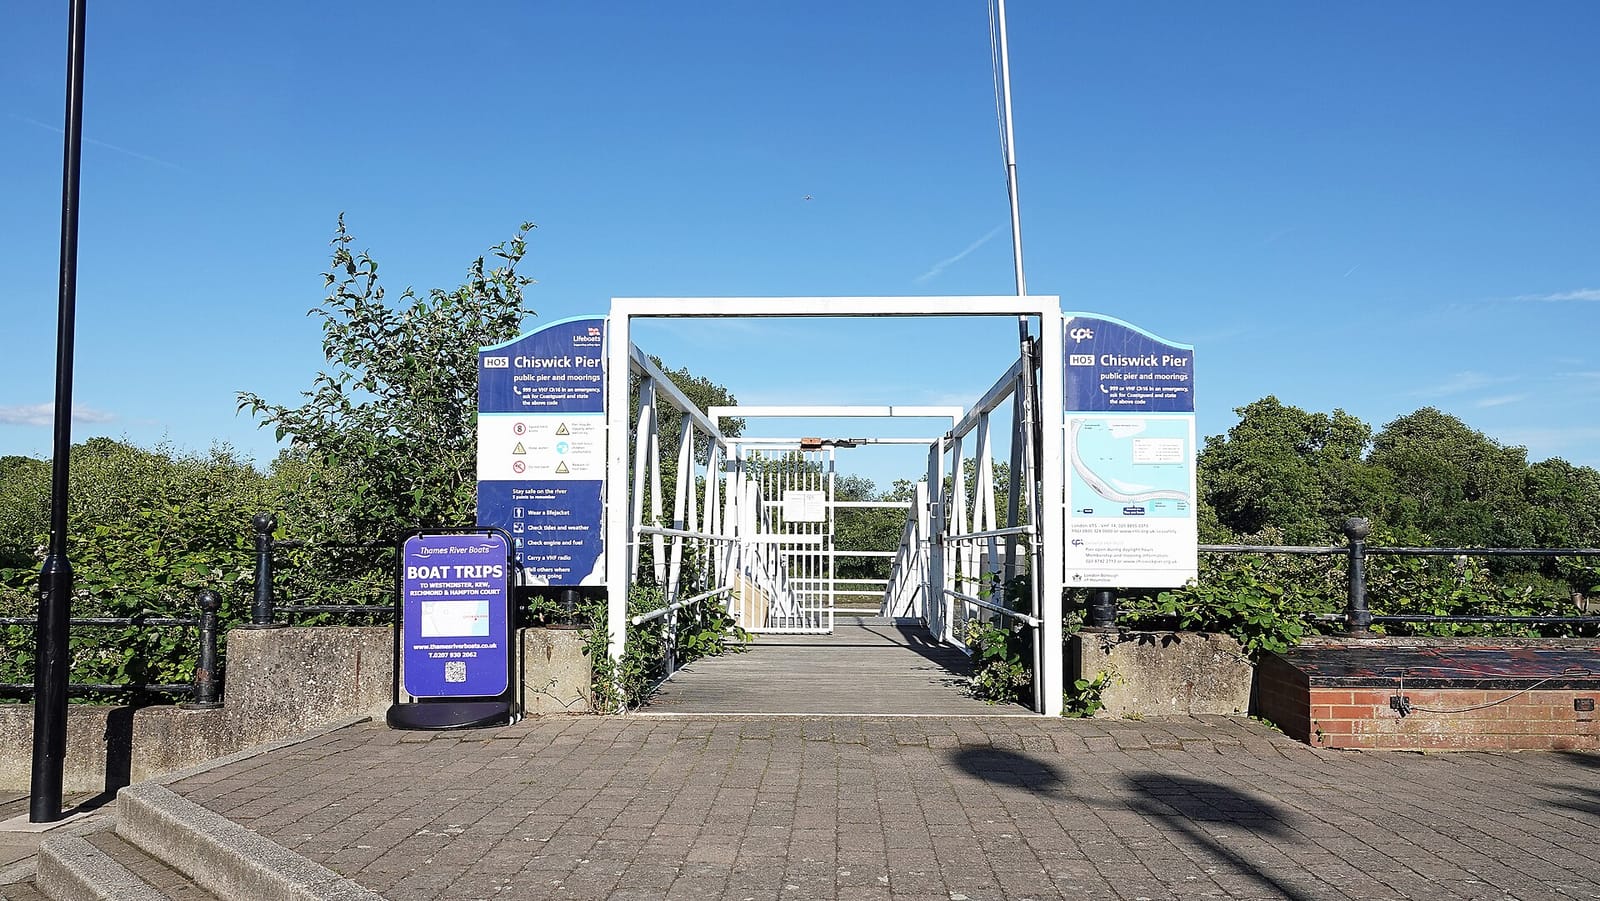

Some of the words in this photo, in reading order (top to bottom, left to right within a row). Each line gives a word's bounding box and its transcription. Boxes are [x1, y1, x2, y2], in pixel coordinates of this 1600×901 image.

[1070, 328, 1094, 343] cpt
[514, 356, 571, 368] Chiswick
[576, 356, 600, 368] Pier
[1100, 354, 1158, 366] Chiswick
[1162, 355, 1188, 366] Pier
[407, 566, 450, 579] BOAT
[454, 565, 502, 579] TRIPS
